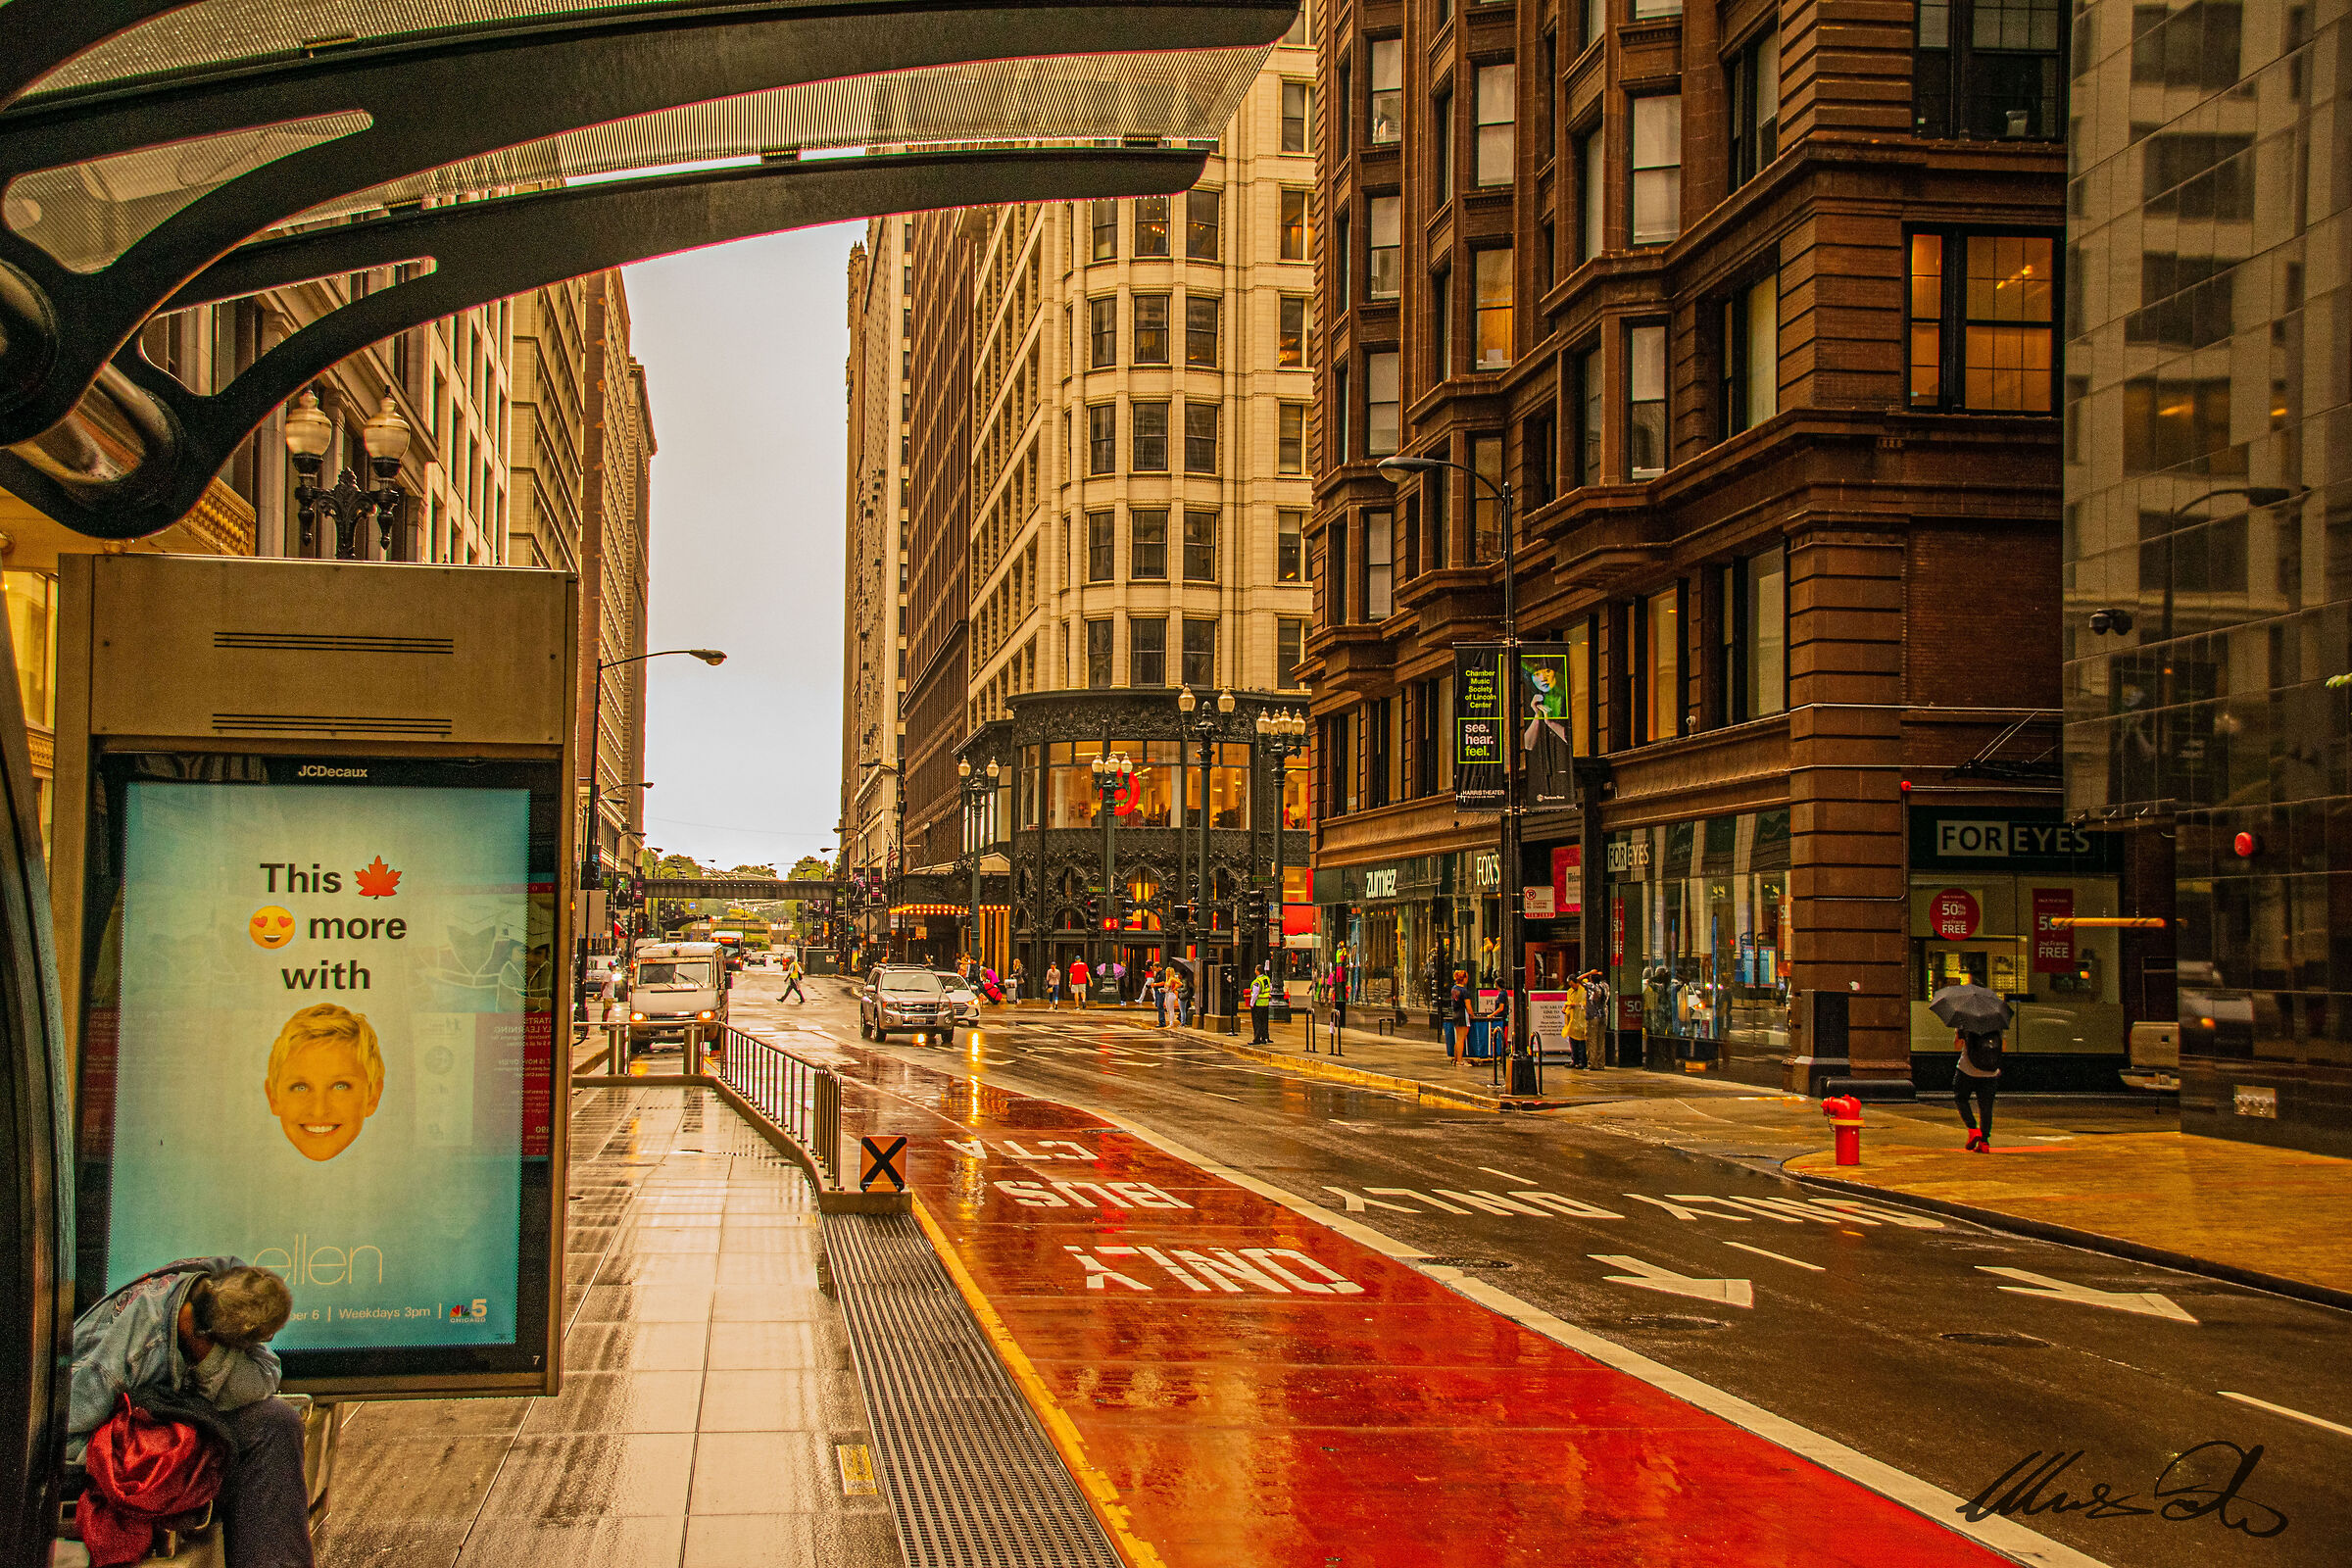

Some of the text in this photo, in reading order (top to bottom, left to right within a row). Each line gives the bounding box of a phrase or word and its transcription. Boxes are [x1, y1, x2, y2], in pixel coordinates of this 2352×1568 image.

[1464, 723, 1490, 733] see.
[1464, 733, 1494, 745] hear.
[1464, 745, 1491, 757] feel.
[298, 764, 368, 778] JCDecaux
[1941, 825, 2090, 853] FOR EYES
[1608, 843, 1649, 868] FOR EYES
[260, 862, 343, 894] This
[1476, 854, 1500, 886] FOX'S
[1365, 868, 1397, 899] zumiez
[309, 917, 408, 940] more
[1941, 924, 1968, 934] FREE
[2038, 947, 2070, 958] FREE
[281, 959, 371, 990] with
[943, 1139, 1100, 1160] CTA
[993, 1180, 1196, 1209] BUS
[1320, 1185, 1627, 1220] ONLY
[1622, 1193, 1946, 1229] ONLY
[1062, 1245, 1366, 1294] ONLY
[311, 1310, 320, 1321] 6
[339, 1306, 401, 1320] Weekdays
[404, 1305, 431, 1320] 3pm
[470, 1298, 488, 1316] 5
[532, 1354, 541, 1365] 7
